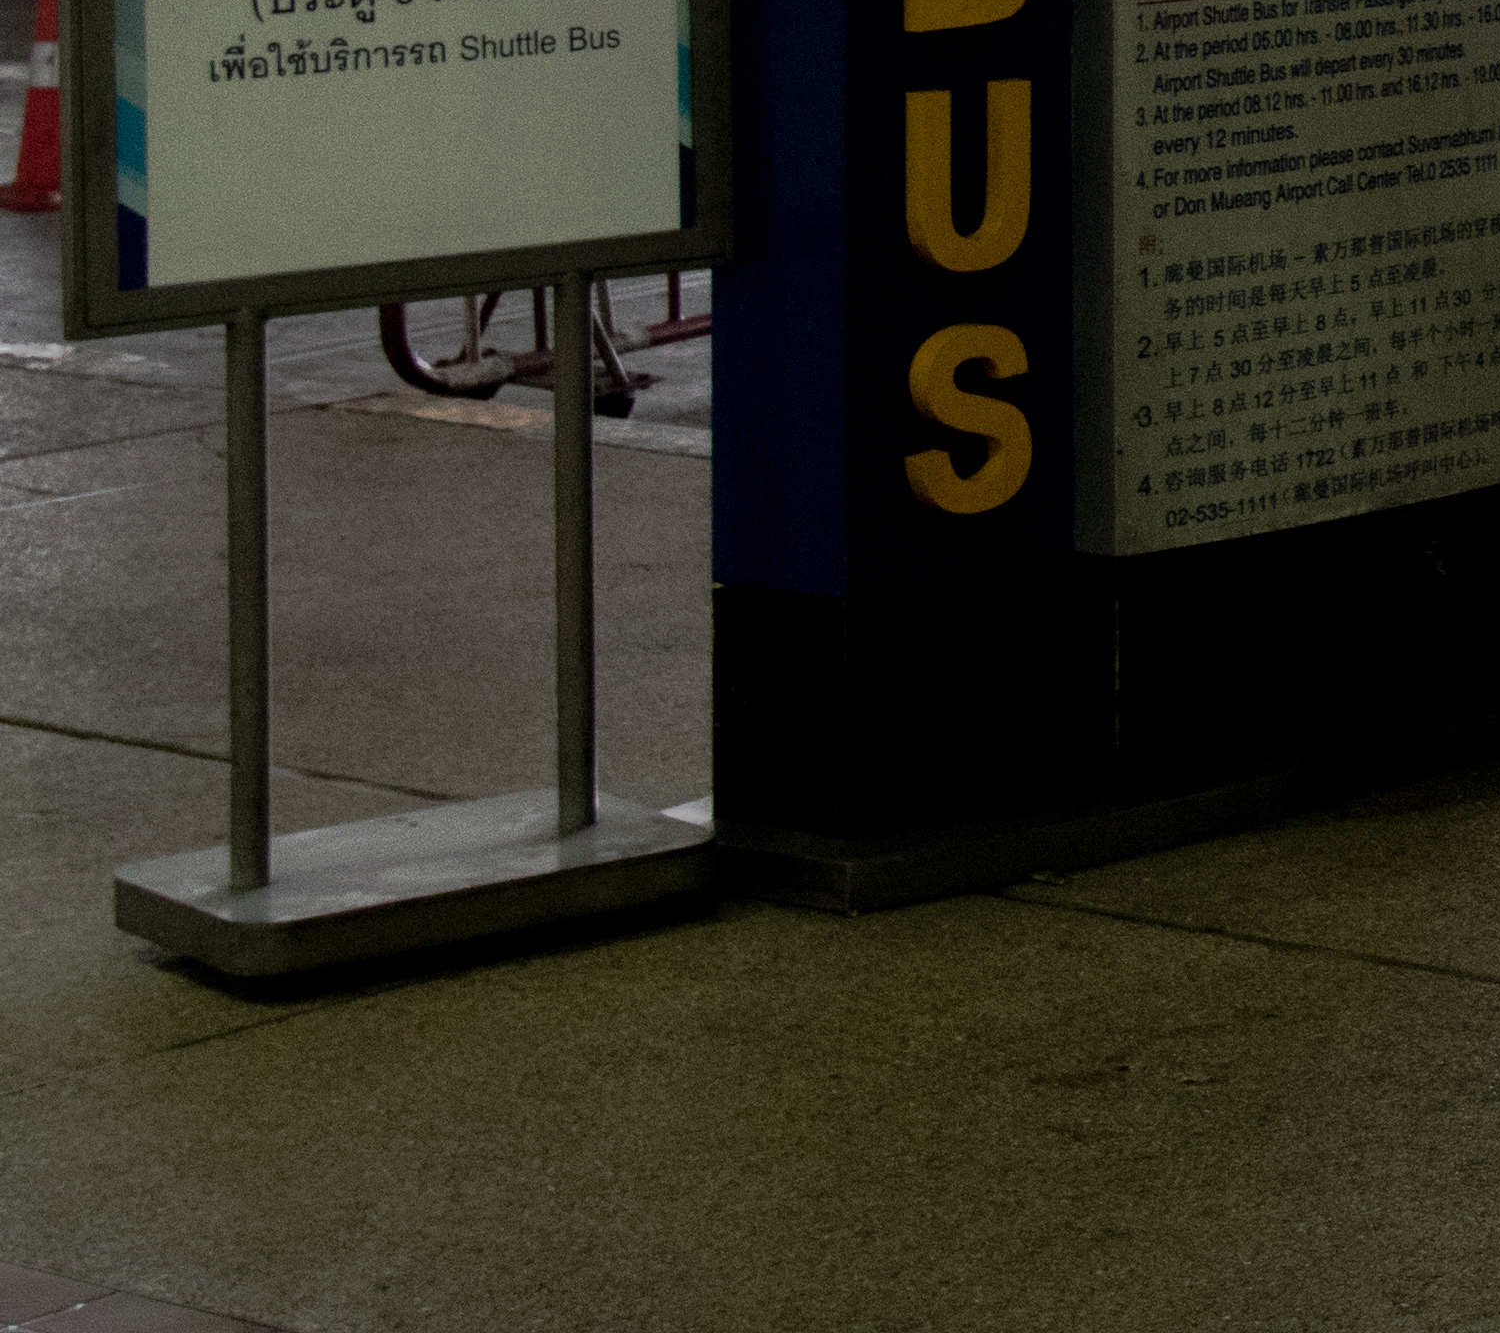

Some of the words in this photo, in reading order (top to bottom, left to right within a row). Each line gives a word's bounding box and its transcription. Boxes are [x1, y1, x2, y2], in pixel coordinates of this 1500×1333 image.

[1153, 10, 1199, 33] Airport
[1203, 4, 1248, 25] Shuttle
[1253, 1, 1278, 21] Bus
[1281, 0, 1298, 17] for
[210, 34, 446, 82] เพื่อใช้บริการรถ
[460, 31, 556, 61] Shuttle
[569, 26, 620, 52] Bus
[1153, 202, 1170, 219] or
[1174, 196, 1206, 217] Don
[1211, 190, 1271, 211] Mueang
[1276, 181, 1323, 204] Airport
[1326, 177, 1353, 196] Call
[1357, 171, 1402, 192] Center
[1439, 157, 1471, 179] 2535
